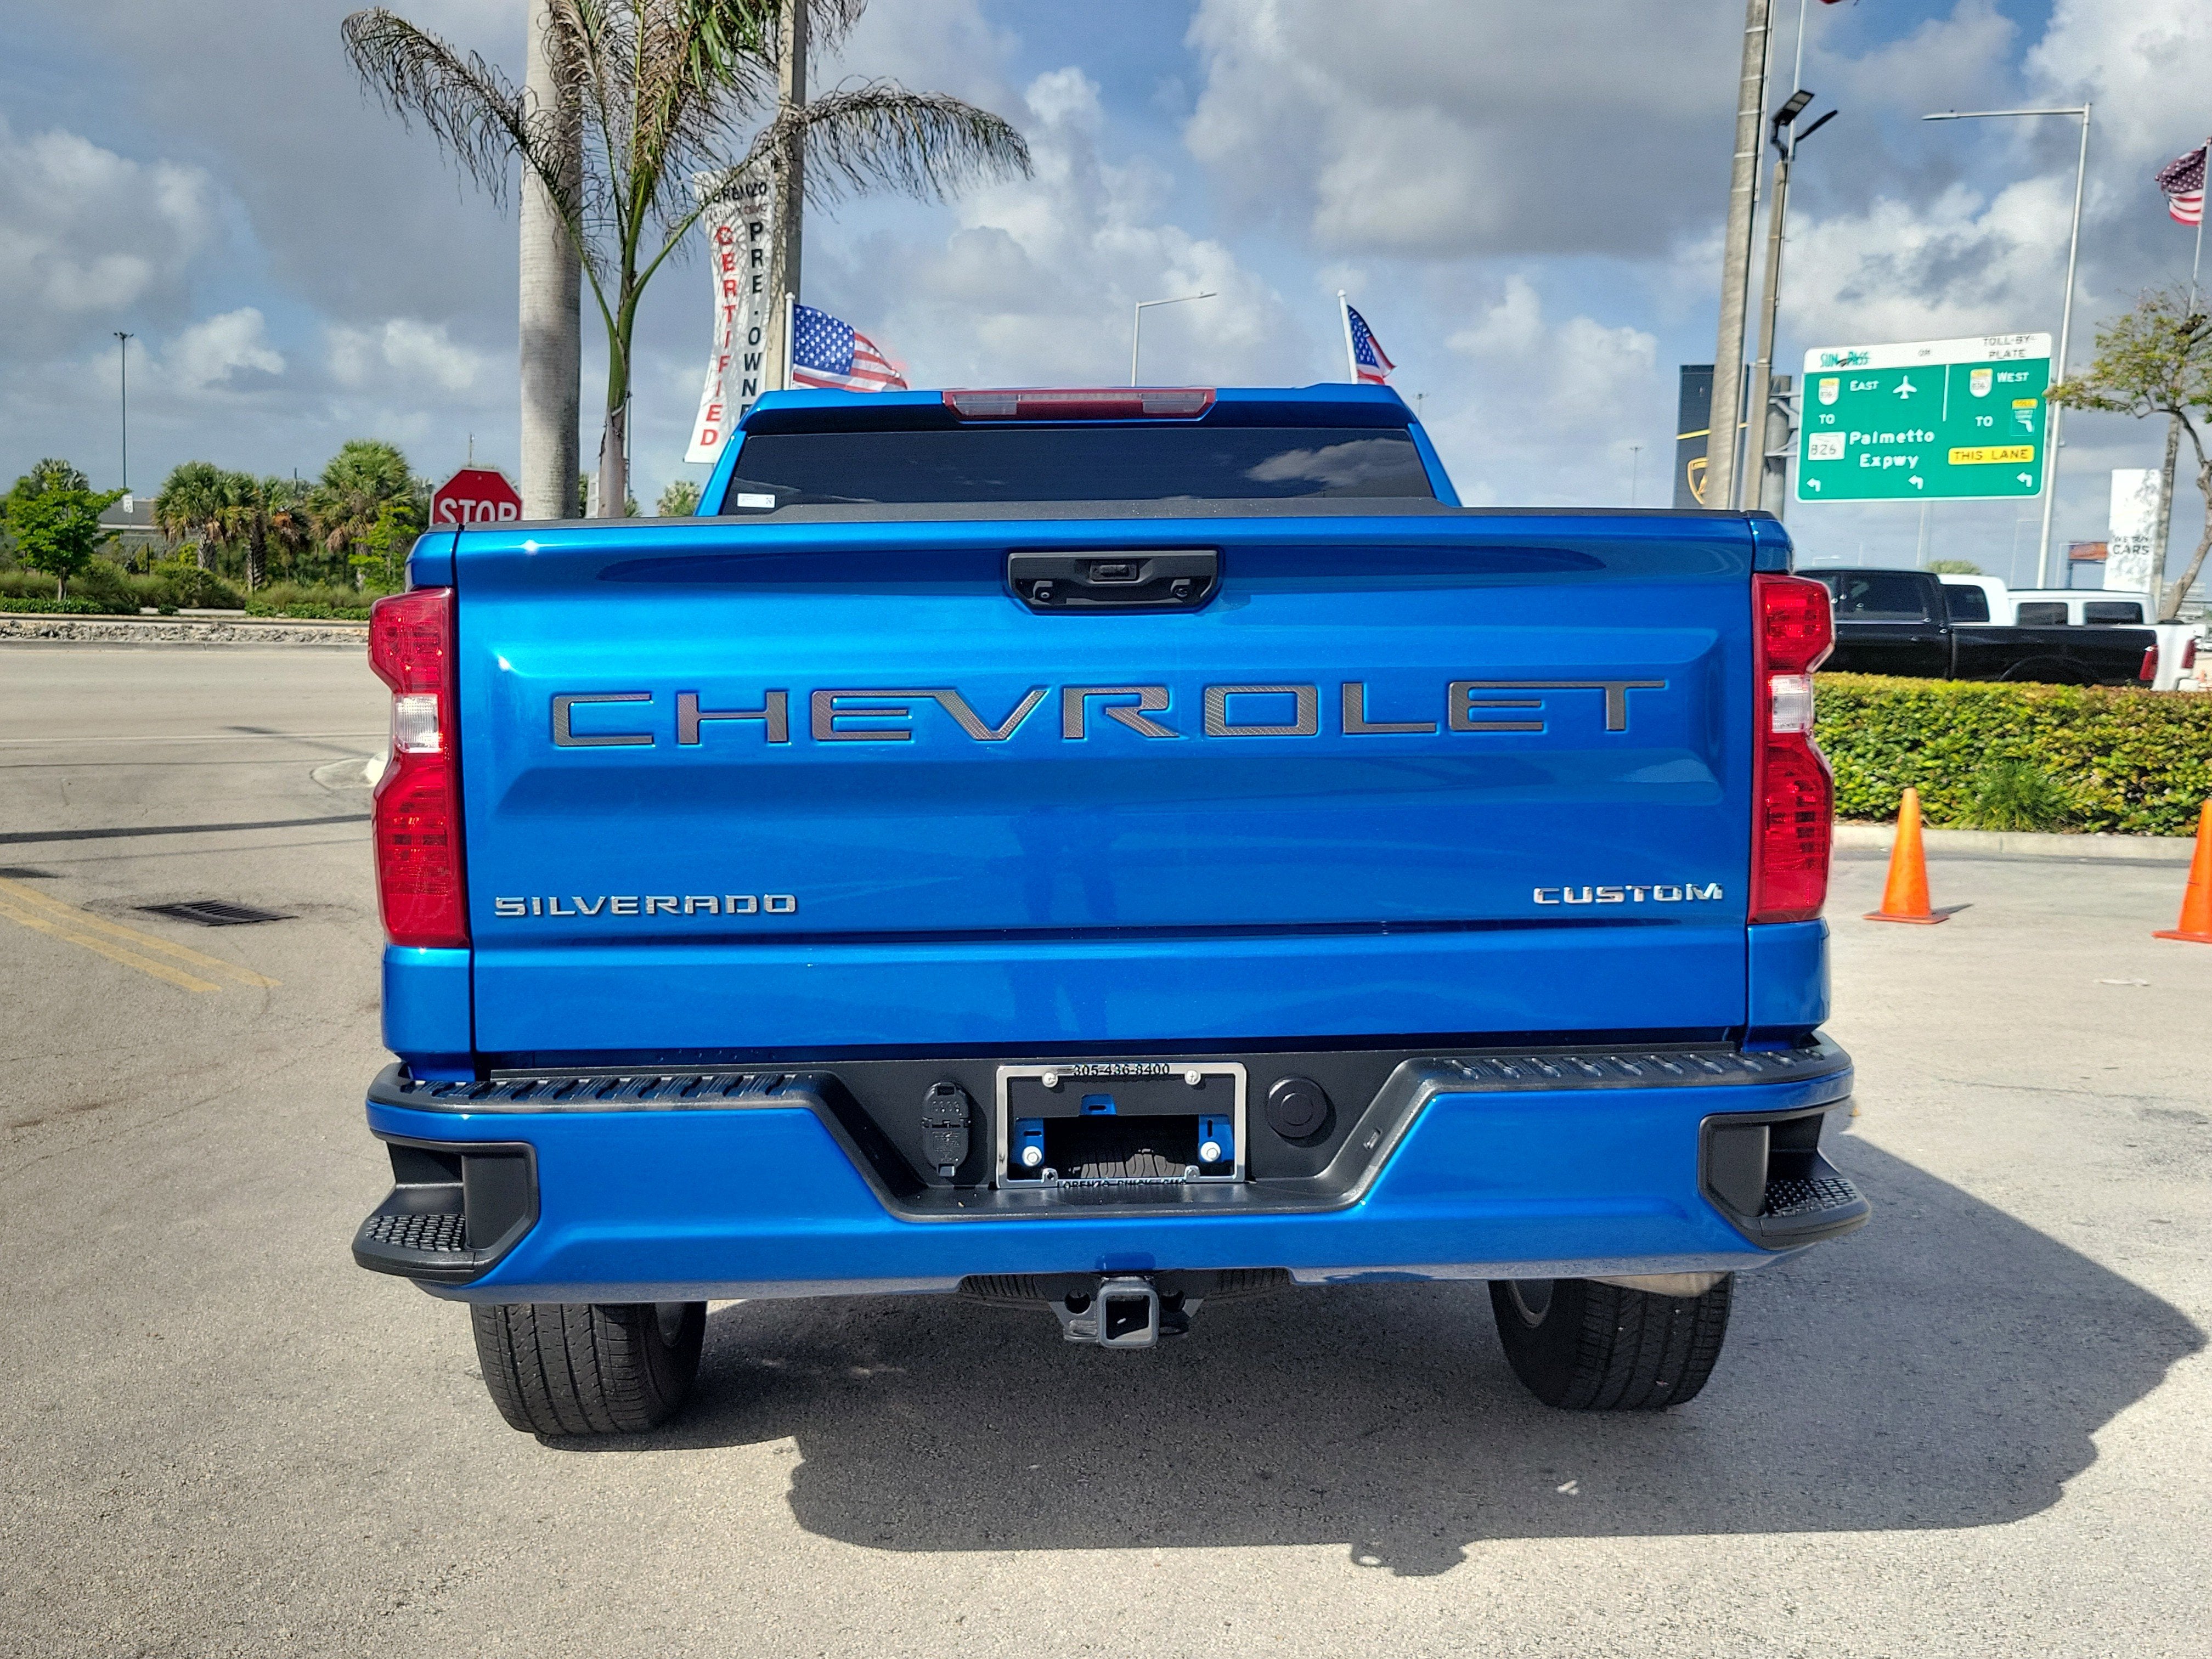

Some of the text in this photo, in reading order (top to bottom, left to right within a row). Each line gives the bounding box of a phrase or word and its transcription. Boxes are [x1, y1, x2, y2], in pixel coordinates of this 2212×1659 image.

[700, 225, 737, 447] CERTIFIED
[1989, 348, 2027, 359] PLATE
[1996, 371, 2030, 383] WEST
[1849, 380, 1880, 392] EAST
[1819, 413, 1836, 425] TO
[1975, 415, 1994, 427] TO
[1849, 428, 1936, 445] Palmetto
[1811, 444, 1836, 455] 826
[1954, 448, 2029, 461] THIS LANE
[1859, 453, 1920, 470] Expwy
[439, 497, 517, 524] STOP
[2113, 544, 2149, 555] CARS
[552, 679, 1668, 747] CHEVROLET
[1532, 882, 1723, 905] CUSTOM
[494, 893, 798, 918] SILVERADO
[1073, 1063, 1170, 1076] 305-436-8400
